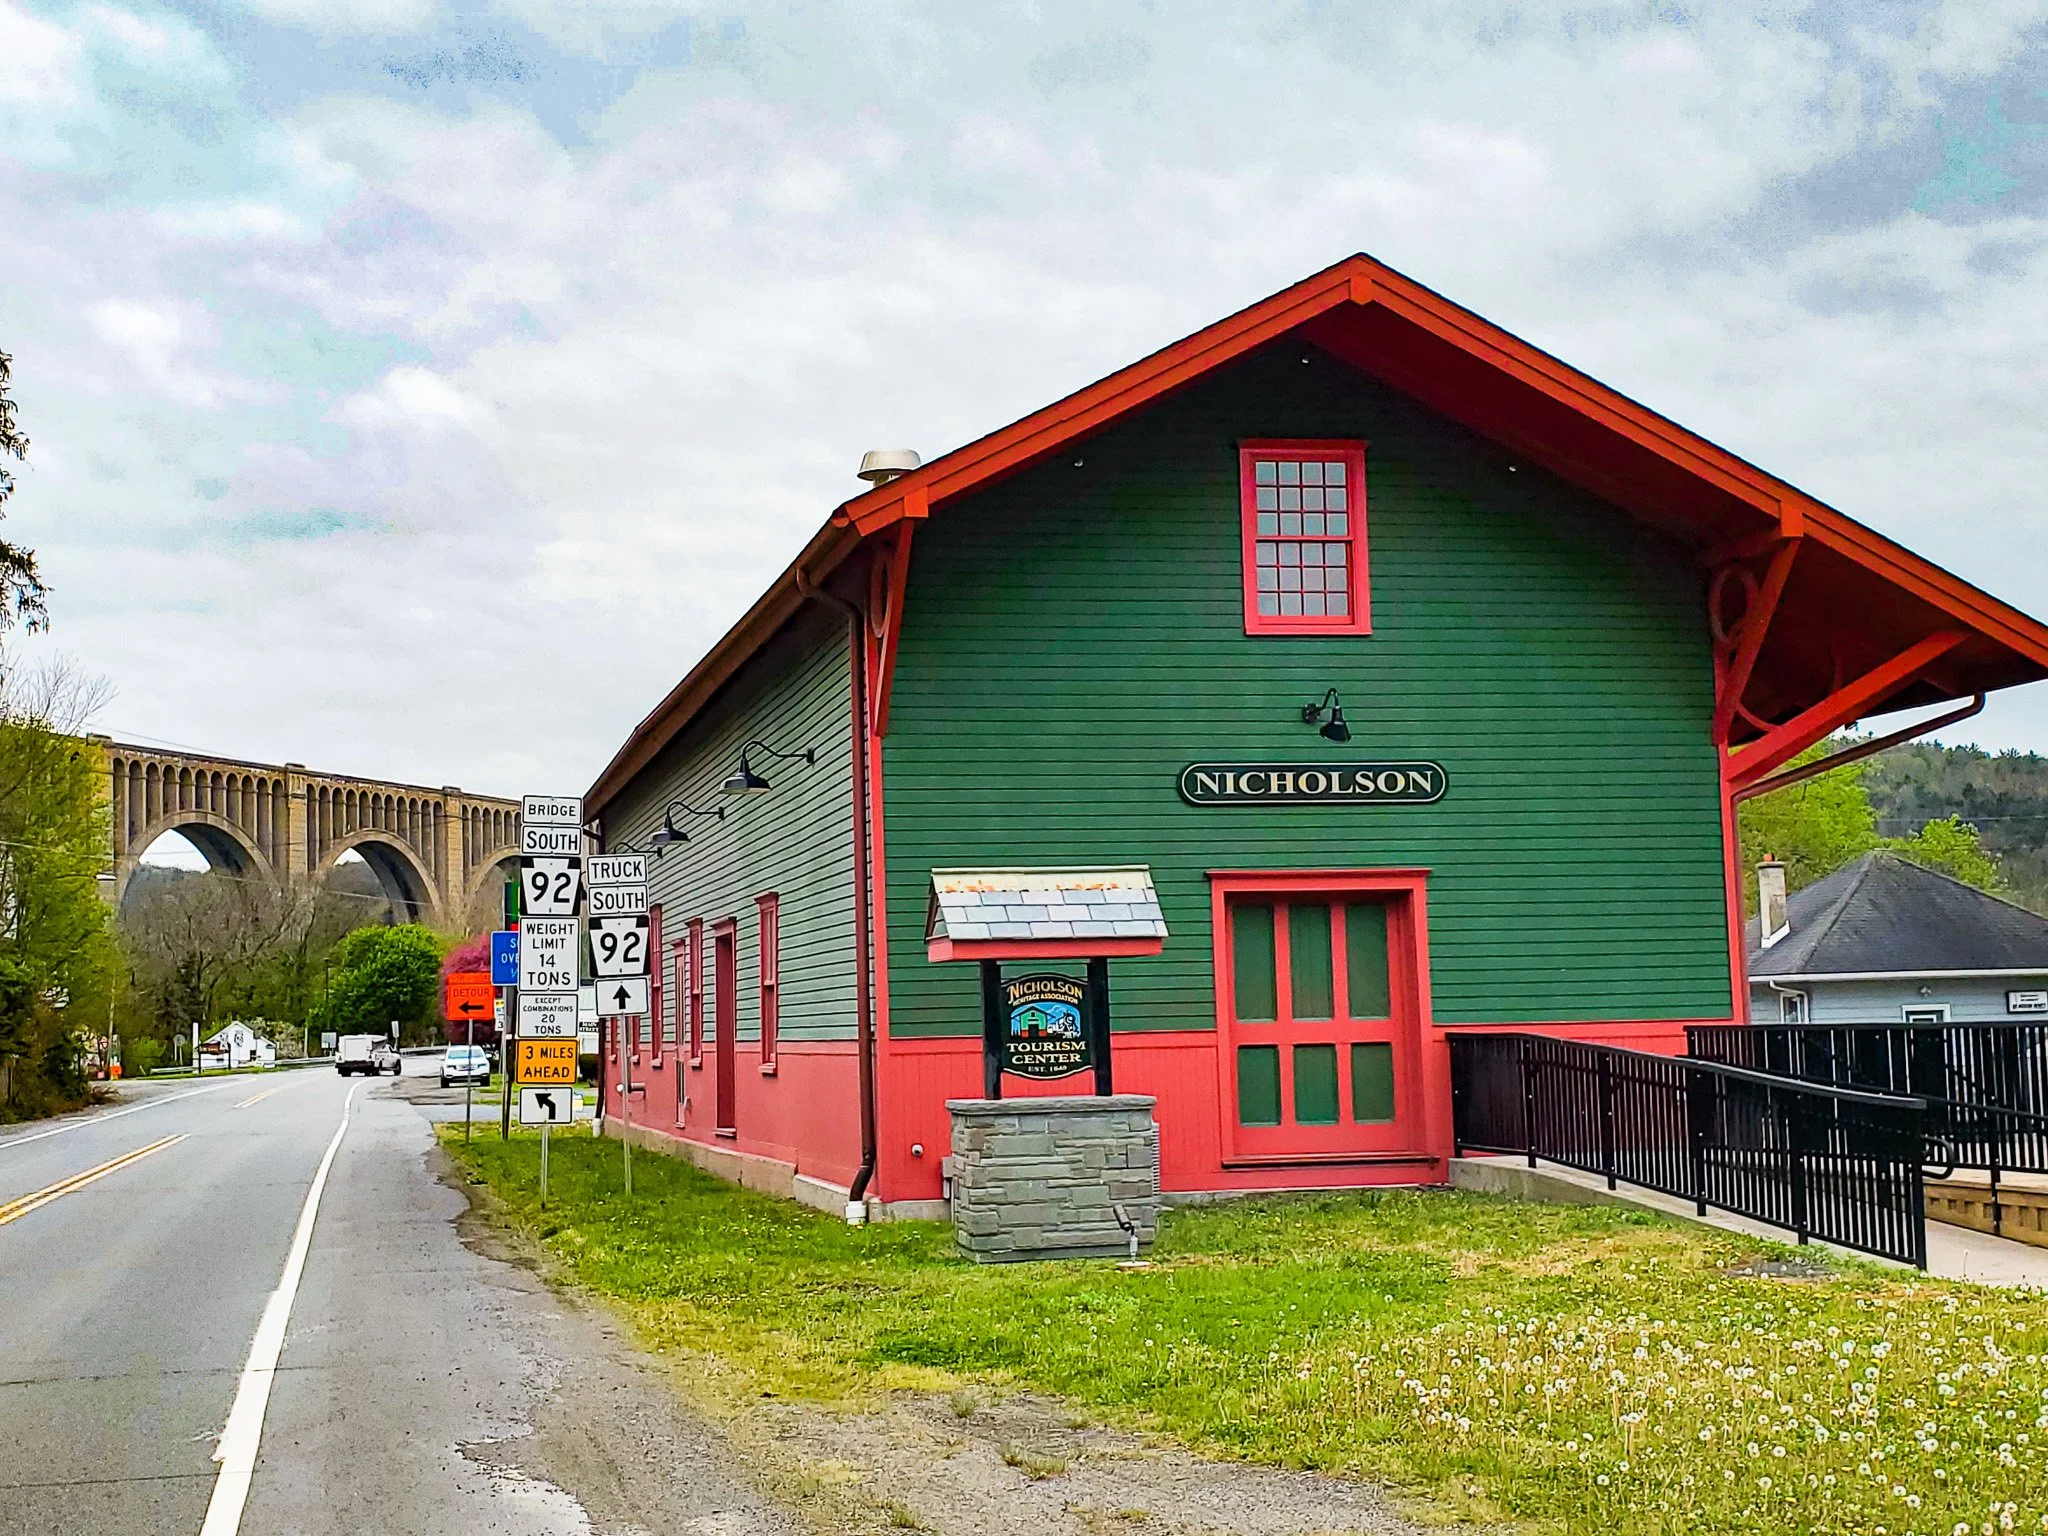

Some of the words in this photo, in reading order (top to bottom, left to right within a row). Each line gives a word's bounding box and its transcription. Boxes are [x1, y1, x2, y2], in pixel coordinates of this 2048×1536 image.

[1194, 771, 1433, 794] NICHOLSON
[528, 804, 576, 816] BRIDGE
[527, 831, 578, 850] SOUTH
[591, 861, 643, 879] TRUCK
[531, 872, 571, 903] 92
[593, 892, 644, 910] SOUTH
[526, 923, 574, 935] WEIGHT
[532, 938, 566, 949] LIMIT
[600, 932, 640, 963] 92
[539, 954, 556, 967] 14
[527, 972, 571, 986] TONS
[453, 988, 490, 997] DETOUR
[1006, 981, 1082, 1004] NICHOLSON
[1013, 994, 1040, 1006] HERITAGE
[1040, 993, 1078, 1004] ASSOCIATION
[541, 1014, 556, 1023] 20
[534, 1025, 562, 1034] TONS
[525, 1045, 534, 1060] 3
[540, 1047, 574, 1059] MILES
[1006, 1041, 1087, 1052] TOURISM
[1011, 1053, 1082, 1064] CENTER
[523, 1066, 570, 1078] AHEAD
